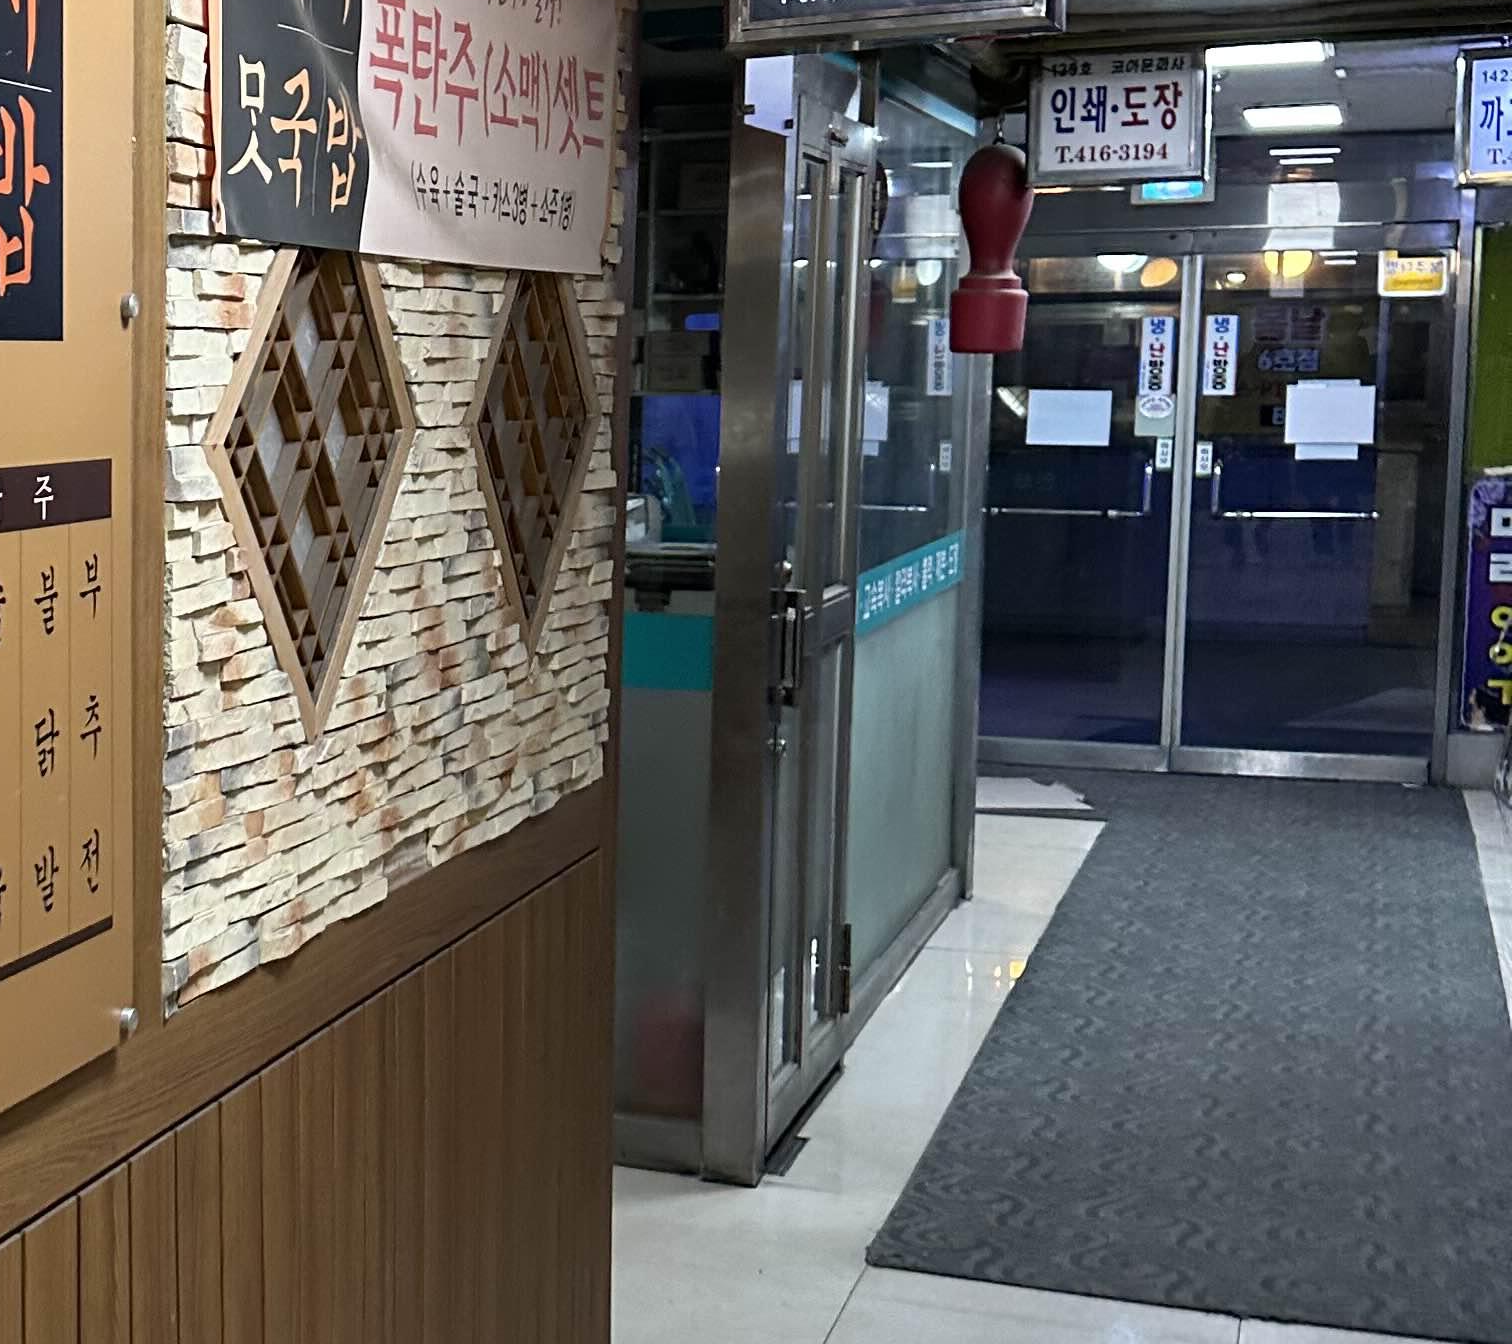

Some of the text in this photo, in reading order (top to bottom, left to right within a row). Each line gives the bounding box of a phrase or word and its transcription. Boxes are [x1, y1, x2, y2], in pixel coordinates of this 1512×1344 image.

[1482, 68, 1512, 84] 142
[1480, 96, 1512, 142] 까
[270, 68, 364, 213] 국밥
[1055, 142, 1168, 164] T.416-3194
